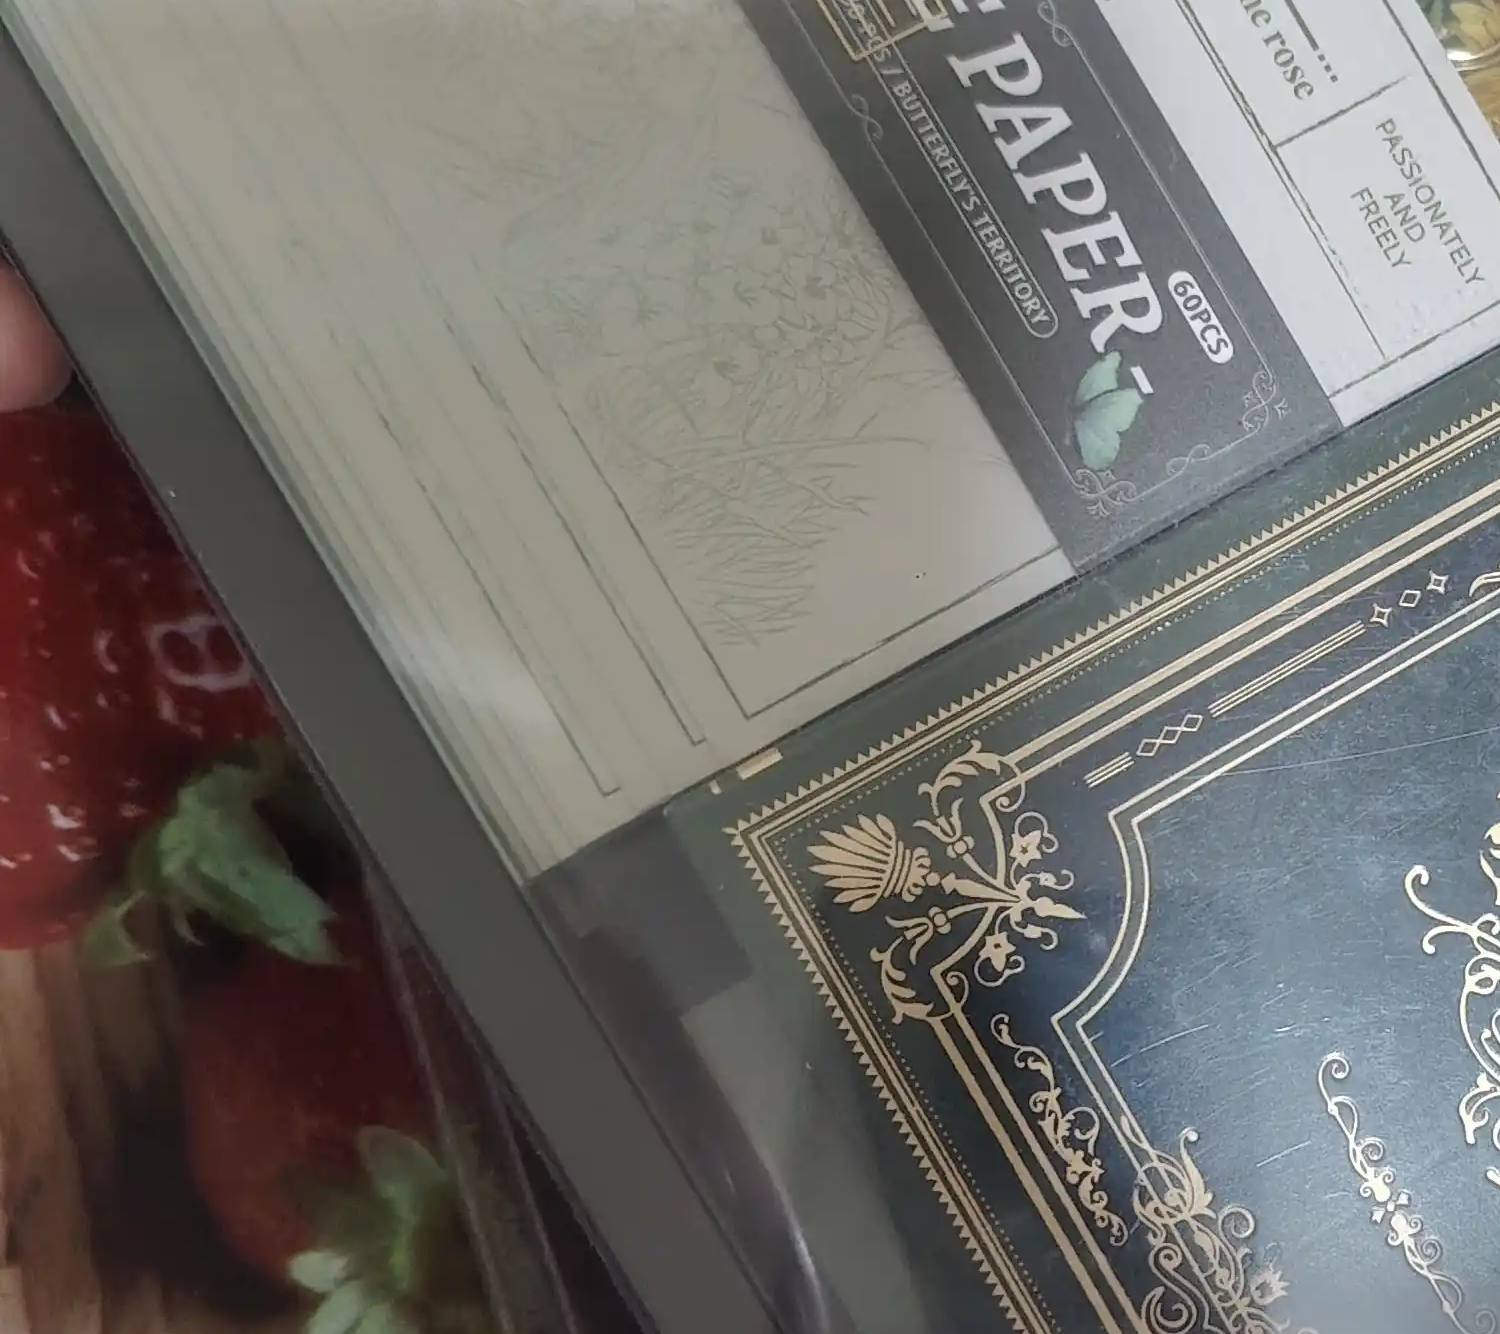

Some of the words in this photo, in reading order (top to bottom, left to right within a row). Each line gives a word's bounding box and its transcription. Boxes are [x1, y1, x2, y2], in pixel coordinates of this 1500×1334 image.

[1263, 31, 1313, 99] rose
[891, 80, 982, 212] BUTTERFLY'S
[970, 210, 1050, 327] TERRITORY
[948, 33, 1161, 352] PAPER
[1351, 187, 1411, 266] FREELY
[1375, 118, 1484, 283] PASSIONATELY
[1383, 193, 1424, 241] AND
[1170, 276, 1233, 357] 60PCS
